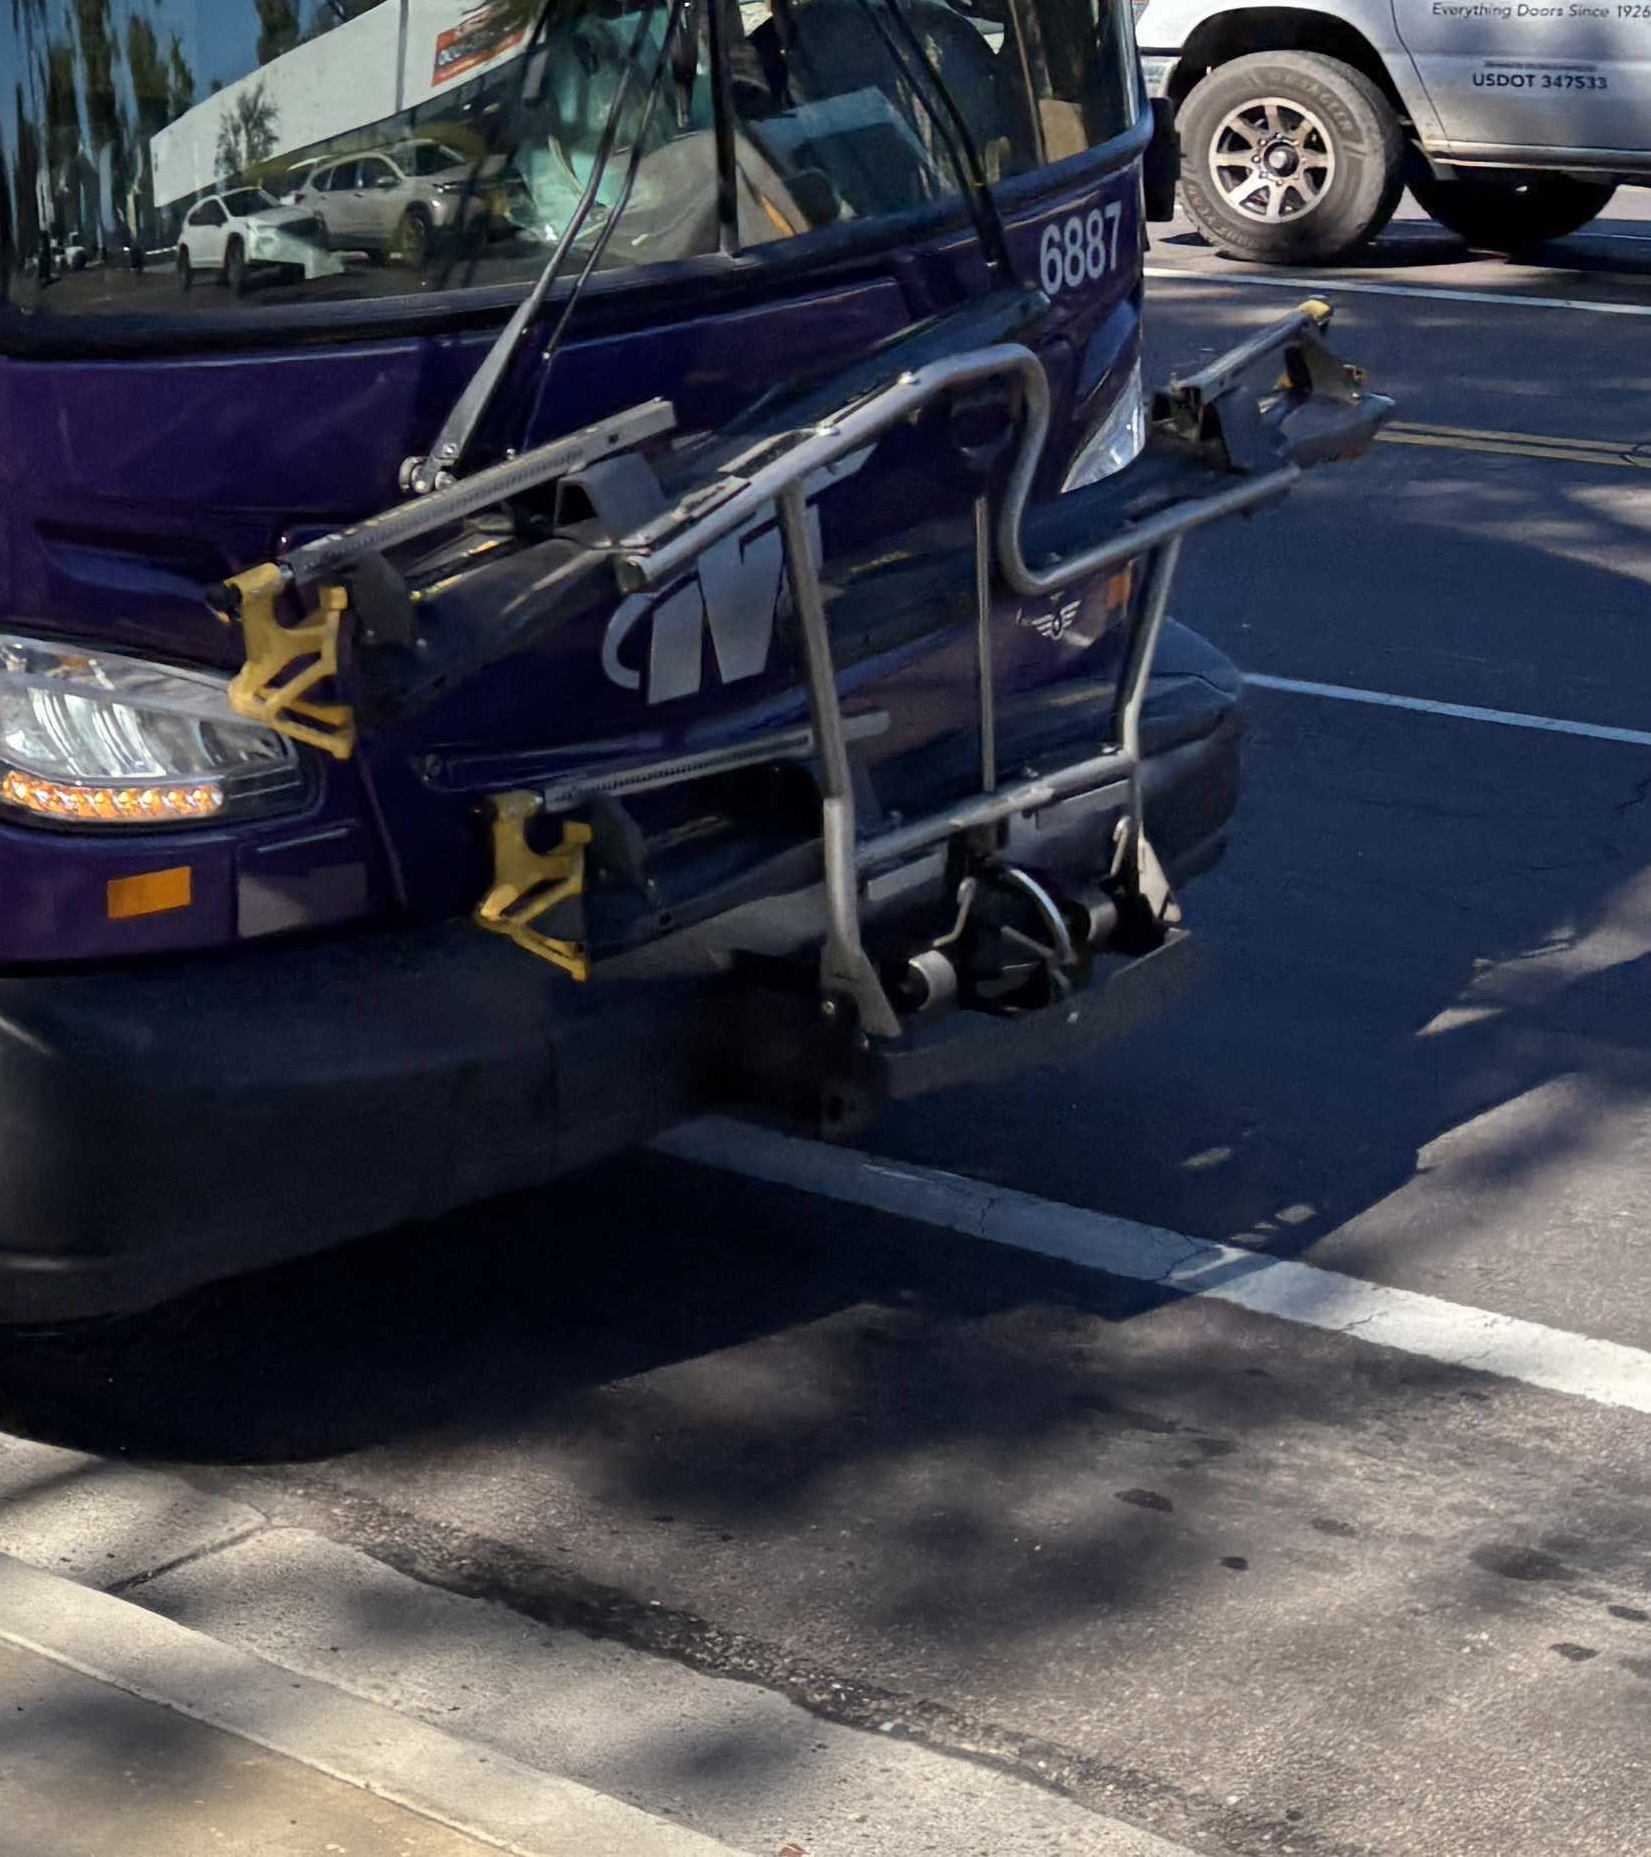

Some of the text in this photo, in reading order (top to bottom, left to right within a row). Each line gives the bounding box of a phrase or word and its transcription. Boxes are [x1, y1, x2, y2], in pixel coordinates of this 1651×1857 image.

[1432, 2, 1651, 20] Everything Doors Since 1926
[1473, 73, 1608, 90] USDOT 347533
[1040, 200, 1122, 295] 6887
